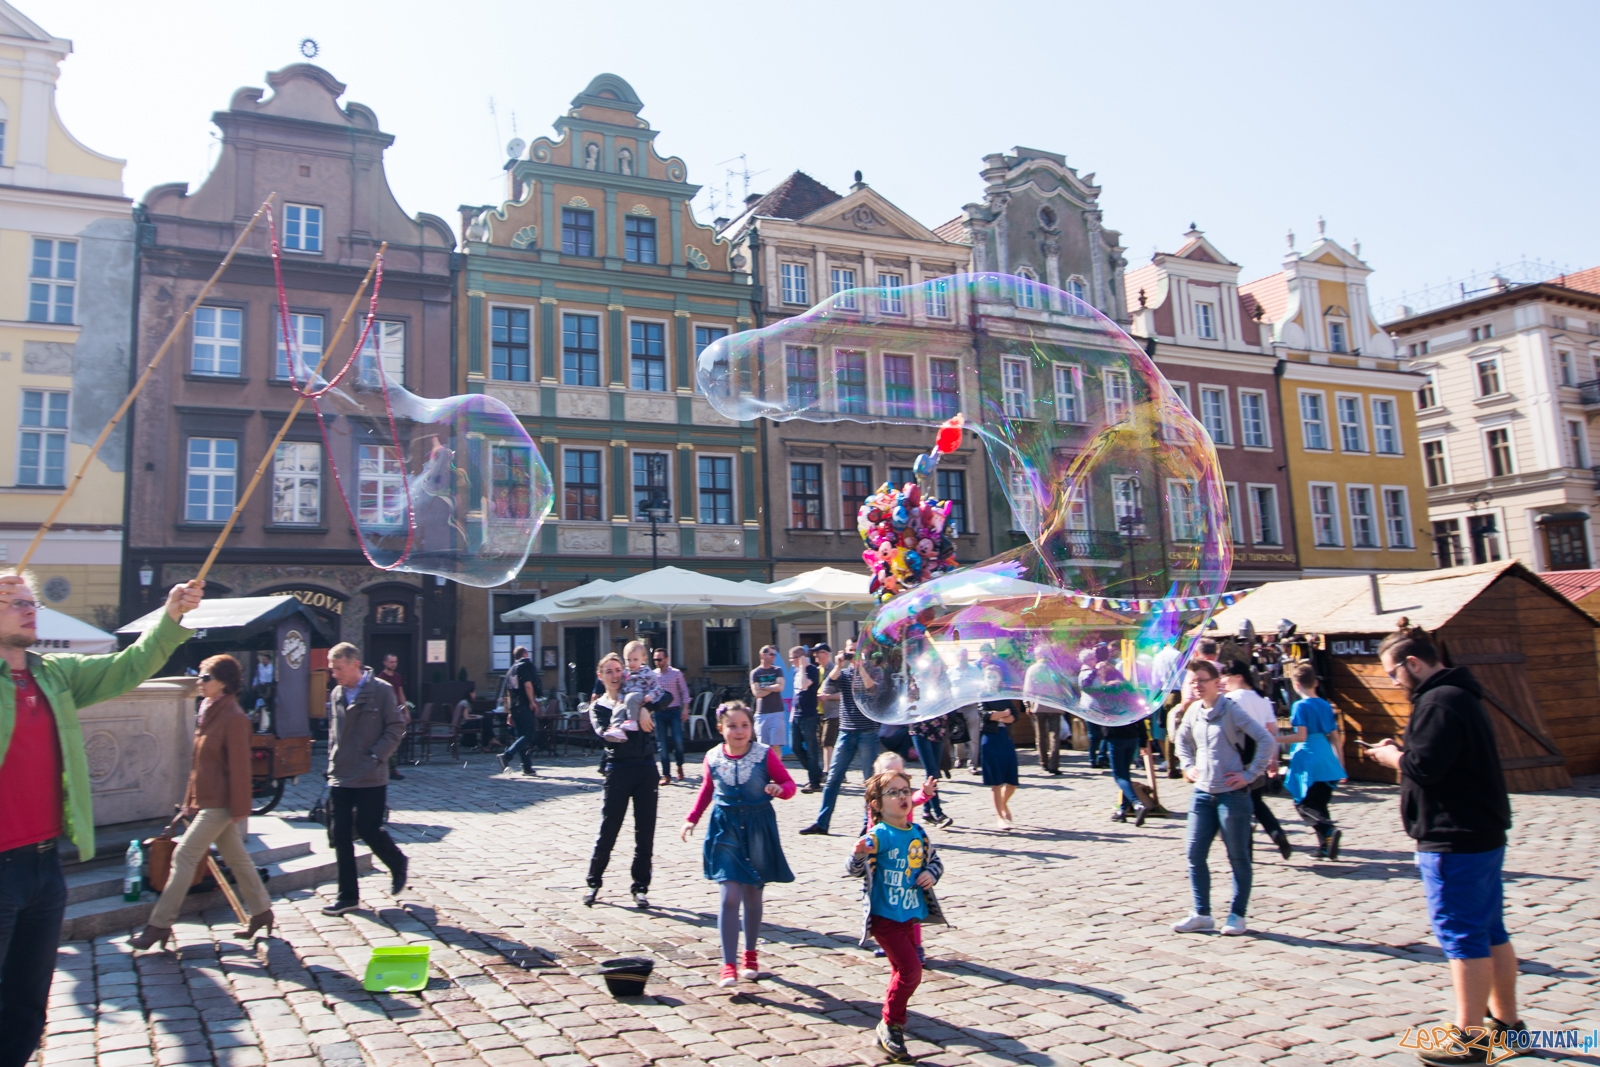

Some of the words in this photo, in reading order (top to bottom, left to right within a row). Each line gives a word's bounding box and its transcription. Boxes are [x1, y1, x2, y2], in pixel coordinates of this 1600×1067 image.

[1331, 640, 1369, 654] KOWAL
[888, 848, 900, 860] UP
[896, 859, 906, 869] TO
[885, 870, 903, 886] NO
